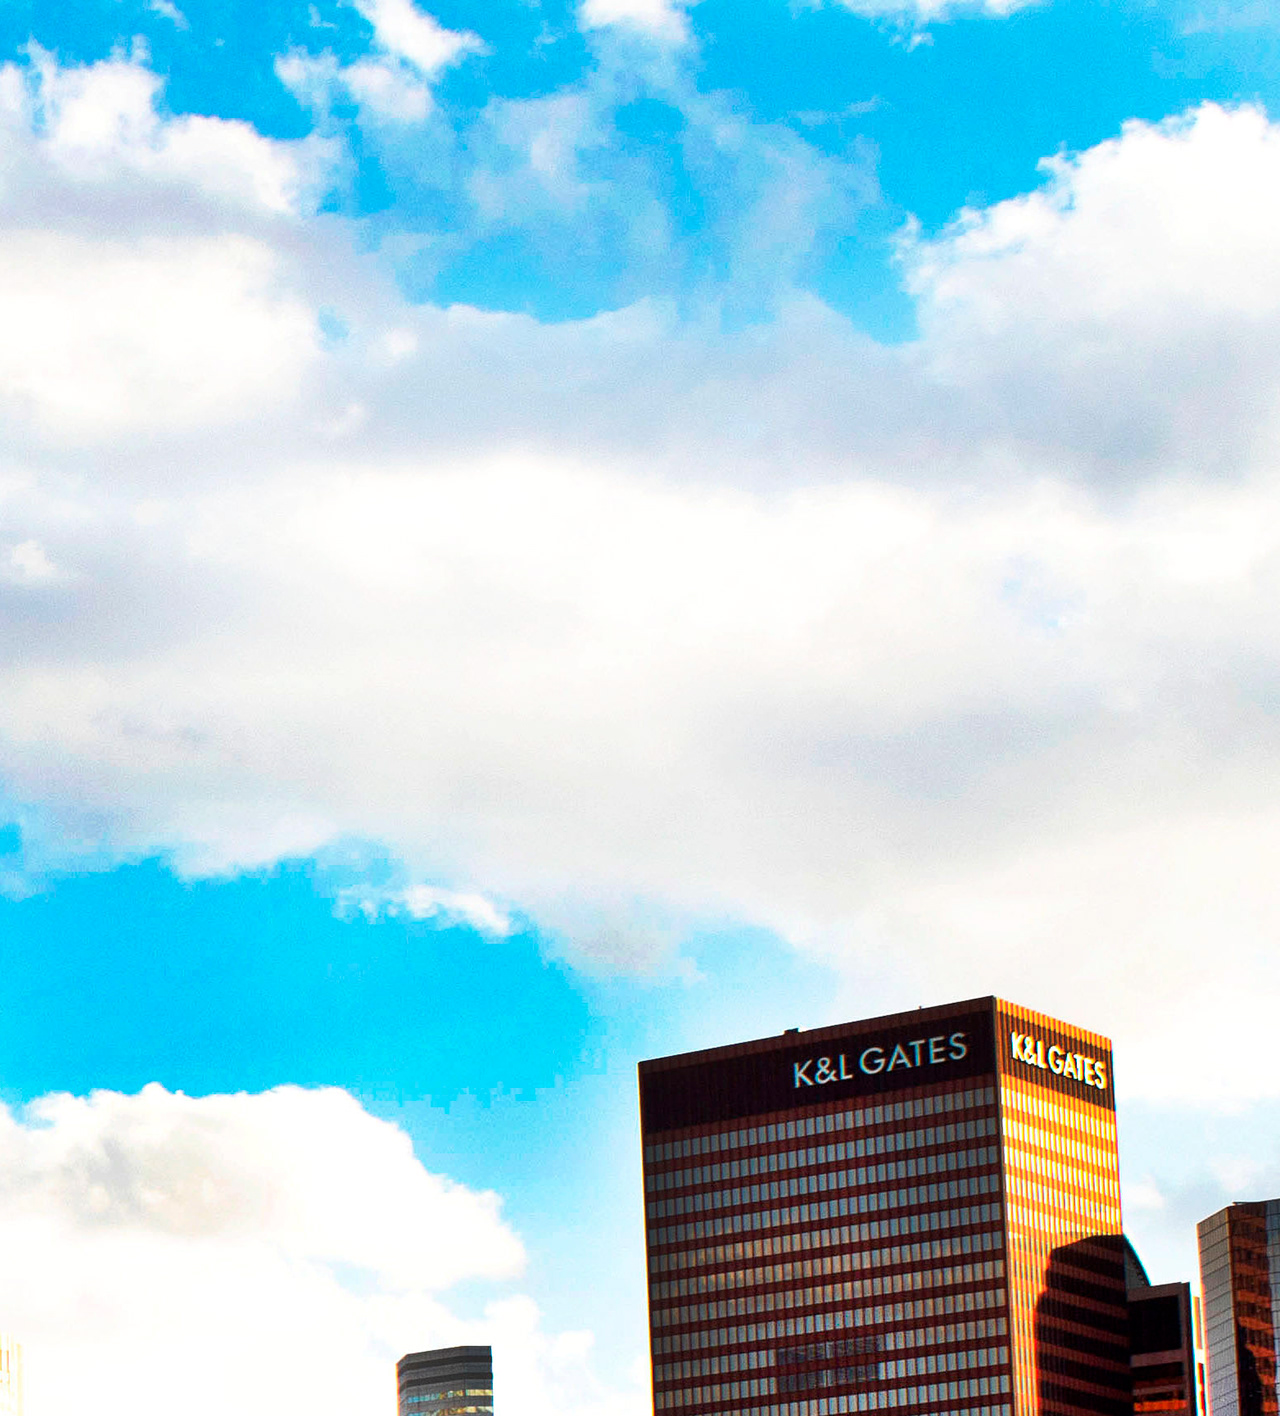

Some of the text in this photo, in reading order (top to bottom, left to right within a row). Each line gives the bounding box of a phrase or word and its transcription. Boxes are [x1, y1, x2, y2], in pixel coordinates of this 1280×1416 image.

[793, 1032, 967, 1088] K&L GATES
[1010, 1031, 1107, 1090] K&L GATES
